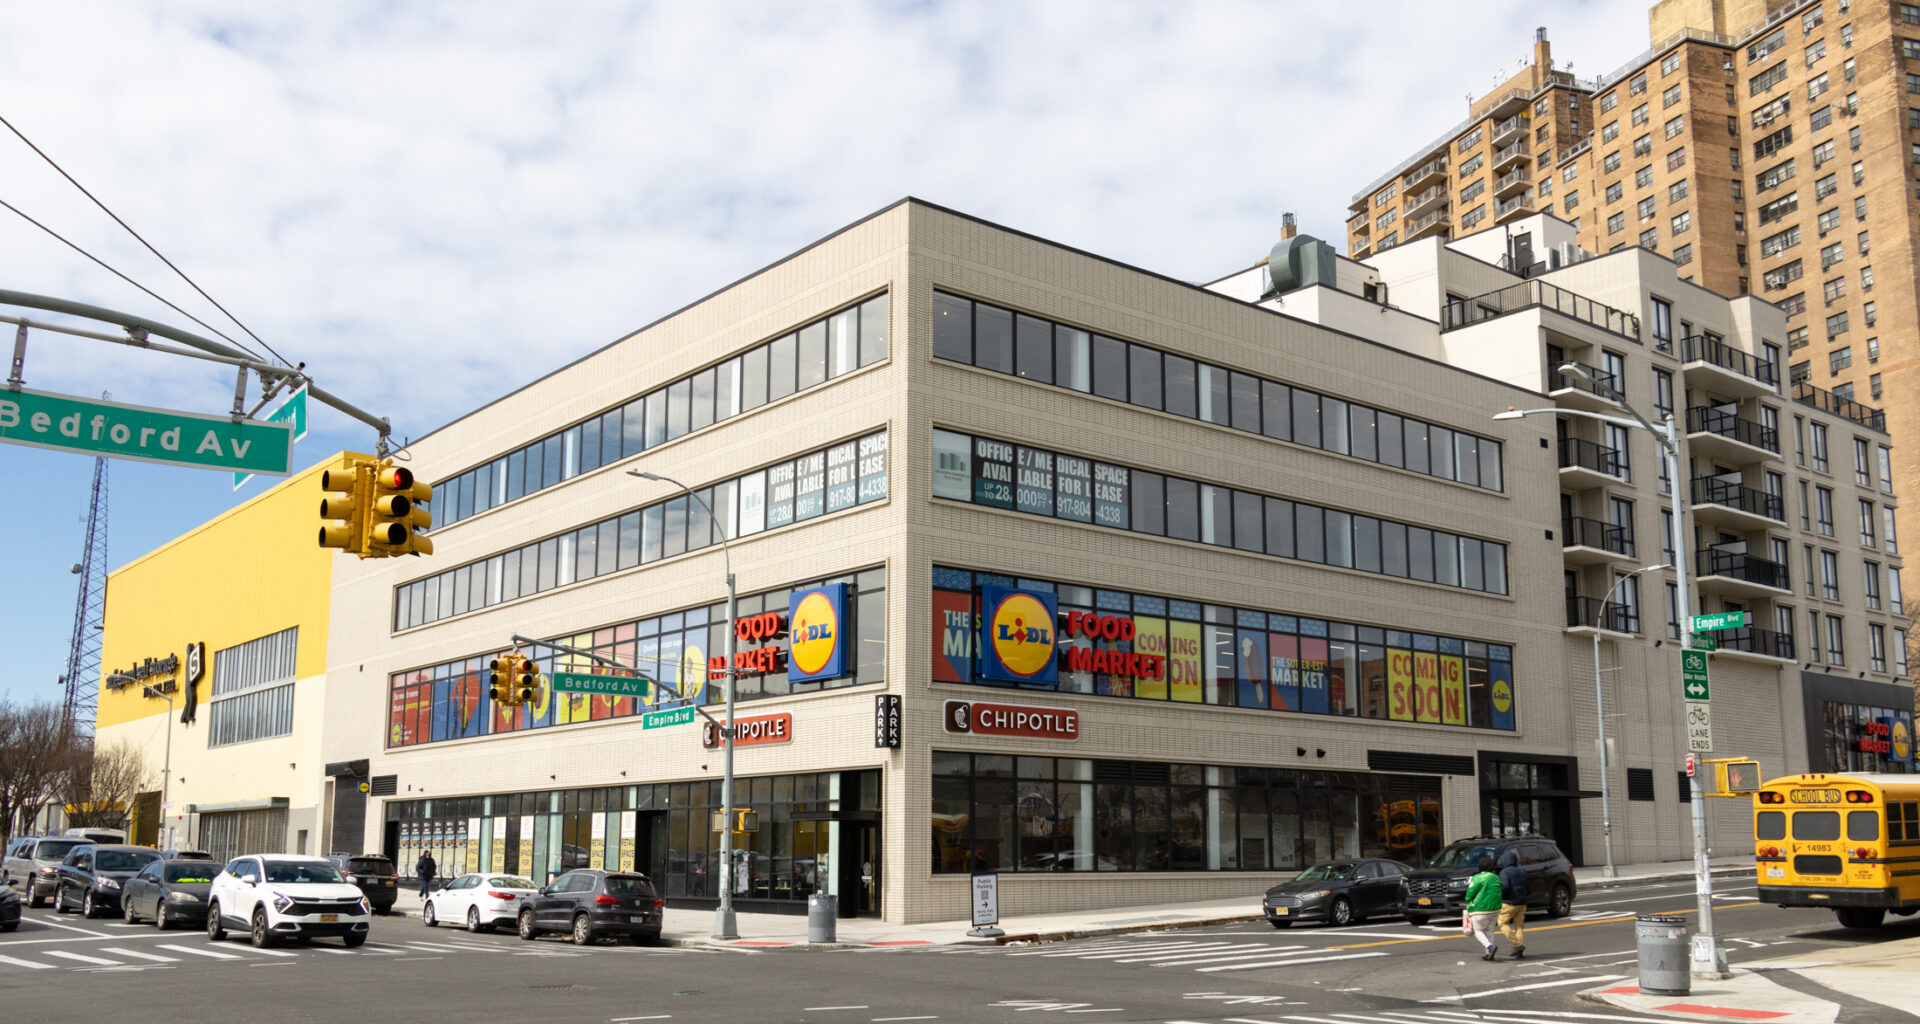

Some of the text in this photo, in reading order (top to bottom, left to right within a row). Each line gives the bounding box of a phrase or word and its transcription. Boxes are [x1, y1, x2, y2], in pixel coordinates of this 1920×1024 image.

[0, 400, 251, 459] Bedford Av
[770, 460, 803, 485] OFFICE
[810, 441, 856, 472] MEDICAL
[978, 441, 1024, 465] OFFICE
[1035, 452, 1090, 478] MEDICAL
[1095, 464, 1128, 486] SPACE
[774, 454, 884, 503] AVAILABLE FOR LEASE
[982, 461, 1052, 490] AVAILABLE
[1058, 476, 1081, 496] FOR
[1085, 482, 1122, 503] LEASE
[995, 484, 1036, 506] 28,000
[1057, 496, 1120, 523] 917-804-4338
[943, 610, 969, 628] THE
[1068, 611, 1136, 641] FOOD
[1696, 614, 1739, 630] Empire Blvd
[708, 646, 779, 680] MRKET
[1068, 646, 1166, 678] MARKET
[1272, 656, 1286, 668] THE
[1393, 654, 1458, 682] COMING
[565, 677, 618, 691] Bedford
[622, 682, 638, 692] Av
[1272, 667, 1325, 689] MARKET
[1393, 681, 1460, 720] SOON
[648, 711, 690, 728] Empire Blvd
[889, 697, 898, 737] PARK
[979, 710, 1076, 733] CHIPOTLE
[1691, 729, 1709, 738] LANE
[1866, 722, 1890, 736] FOOD
[1692, 740, 1710, 750] ENDS
[1859, 738, 1890, 753] MARKET
[1791, 789, 1840, 803] SCHOOL BUS
[1807, 844, 1832, 852] 14983
